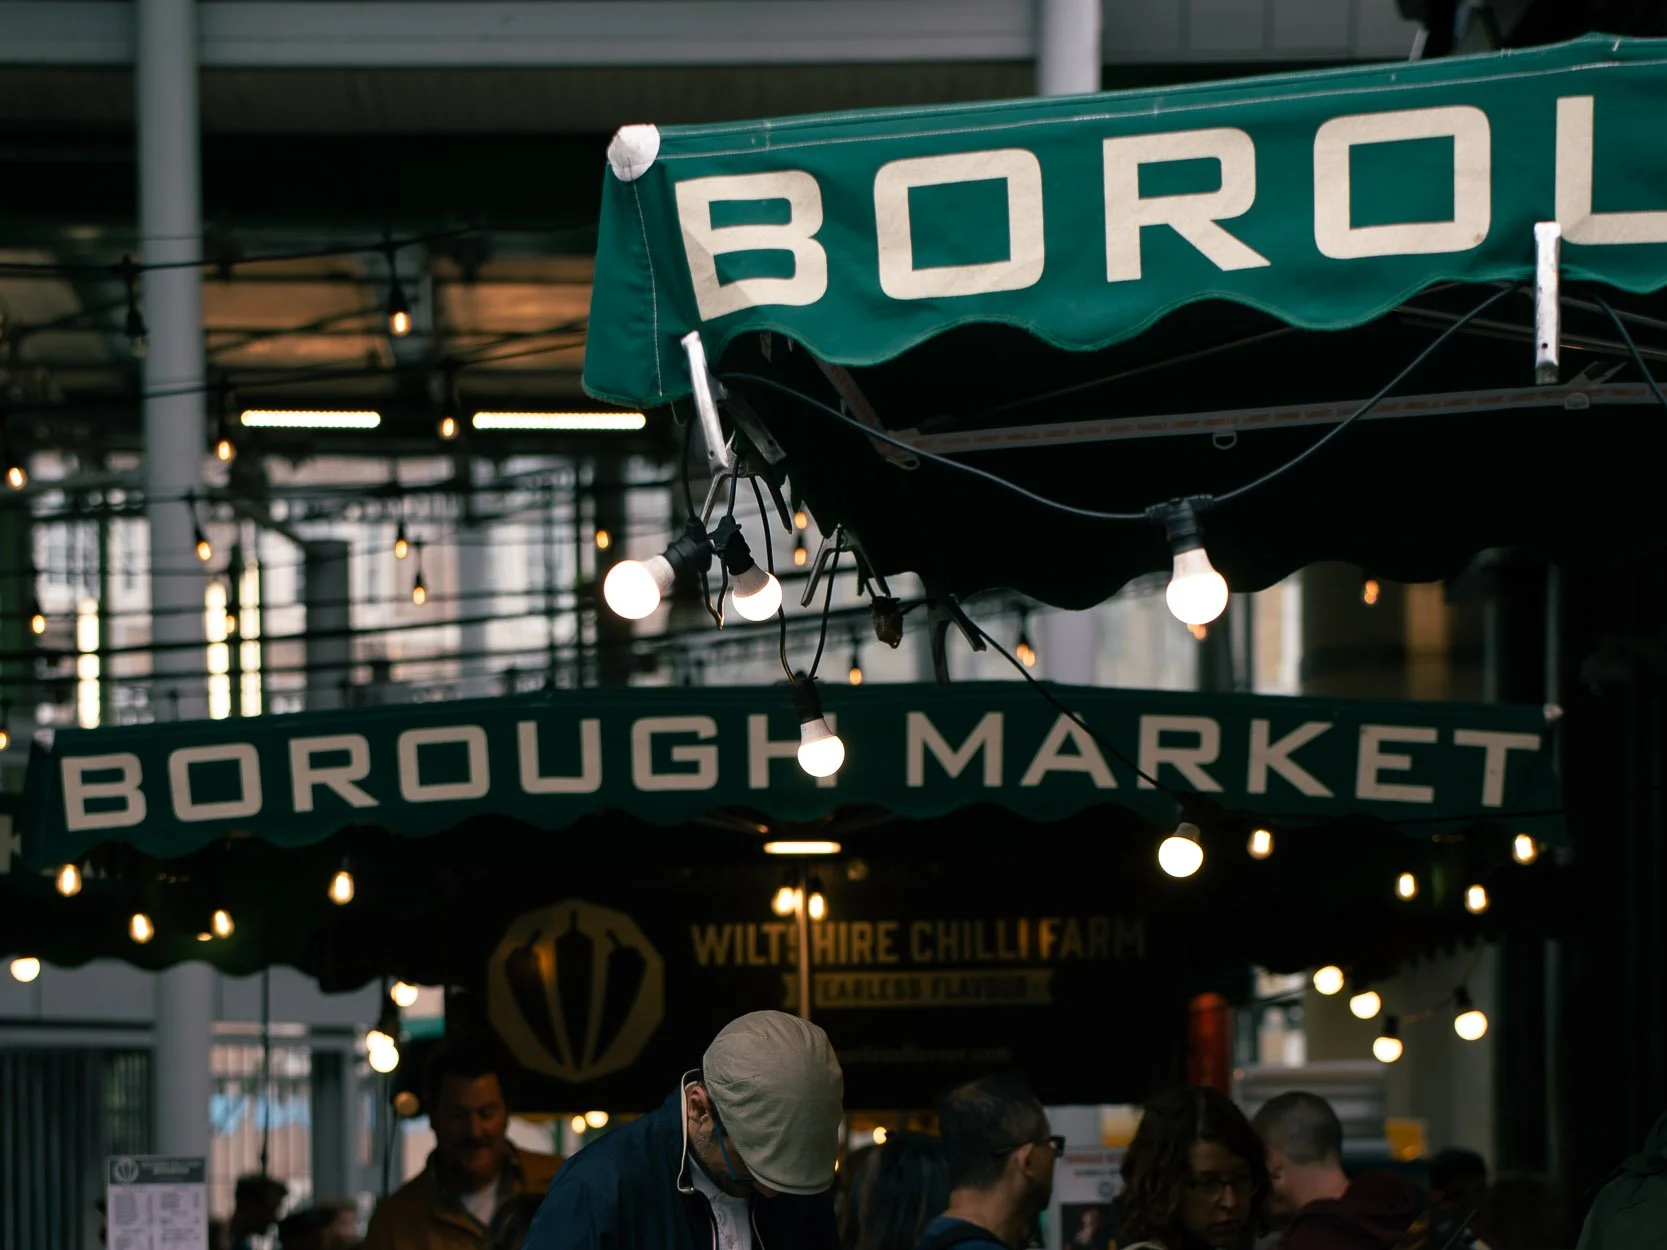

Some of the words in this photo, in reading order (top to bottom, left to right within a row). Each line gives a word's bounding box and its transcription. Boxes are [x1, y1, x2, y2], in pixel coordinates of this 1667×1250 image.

[60, 712, 837, 832] BOROUGH
[906, 711, 1541, 807] MARKET
[910, 917, 1029, 964] CHILLI
[1037, 914, 1147, 960] FARM
